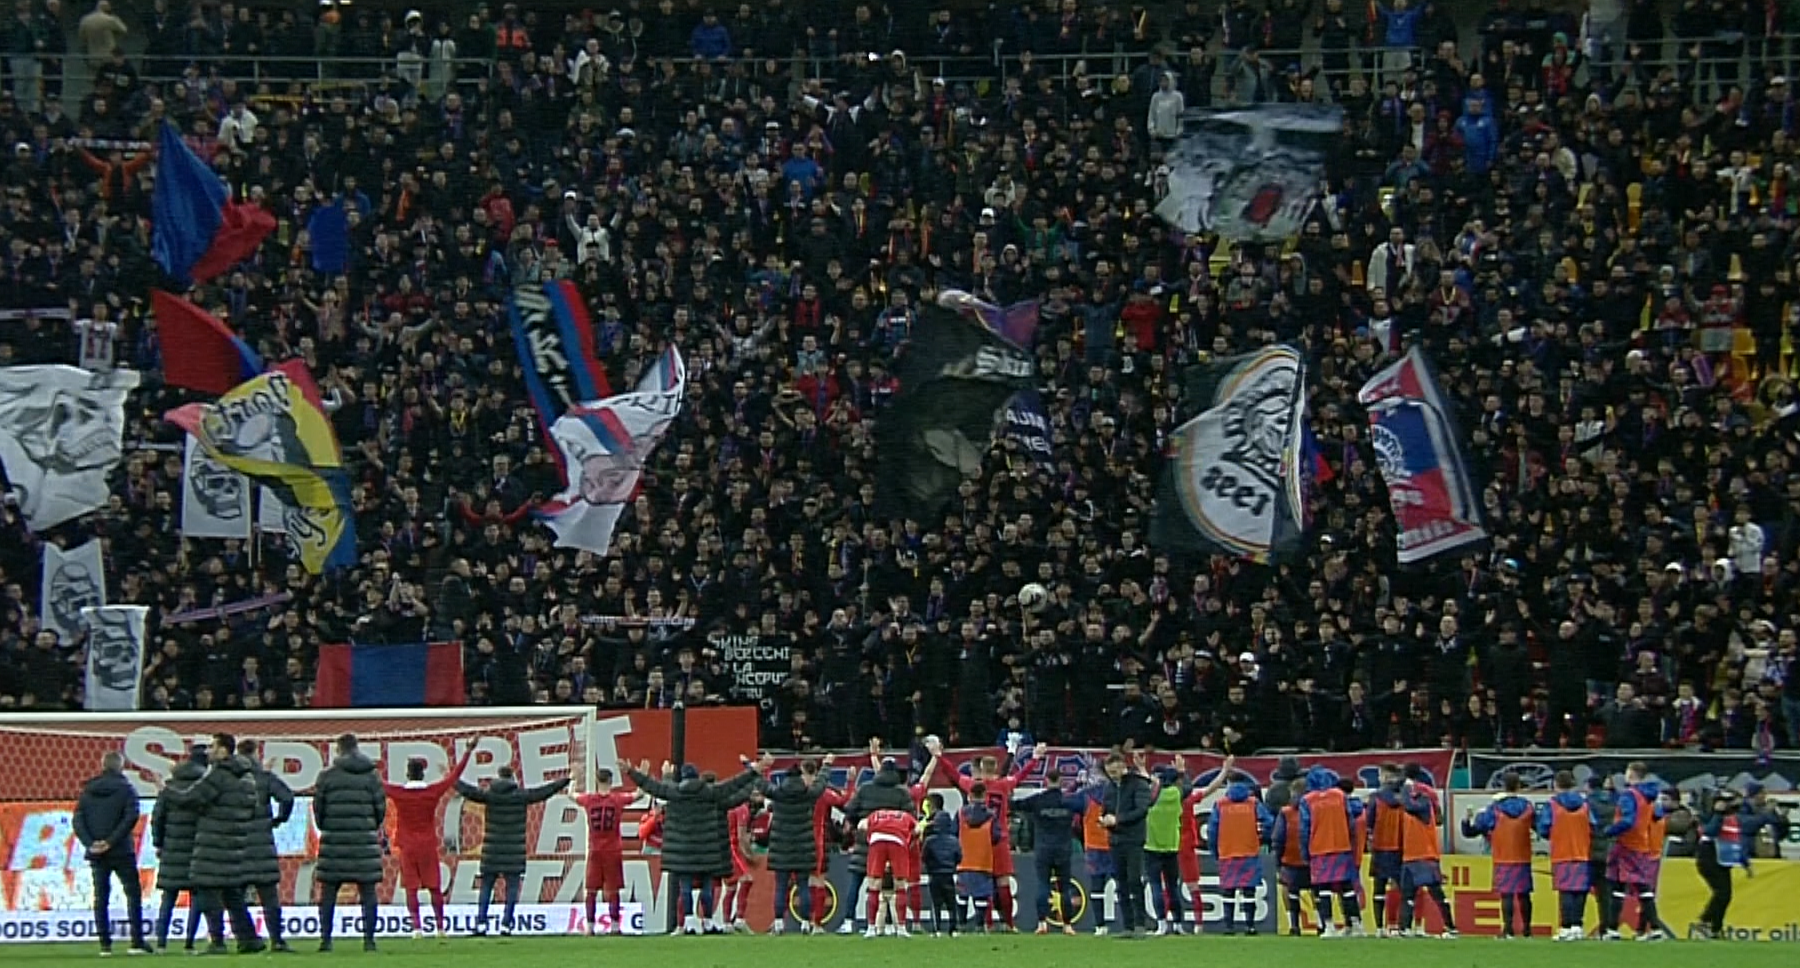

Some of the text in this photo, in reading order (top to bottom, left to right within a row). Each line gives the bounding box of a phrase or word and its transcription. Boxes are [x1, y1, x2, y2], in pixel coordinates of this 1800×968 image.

[125, 714, 632, 796] SPRBET
[0, 921, 49, 938] ODS
[1769, 923, 1800, 941] oil
